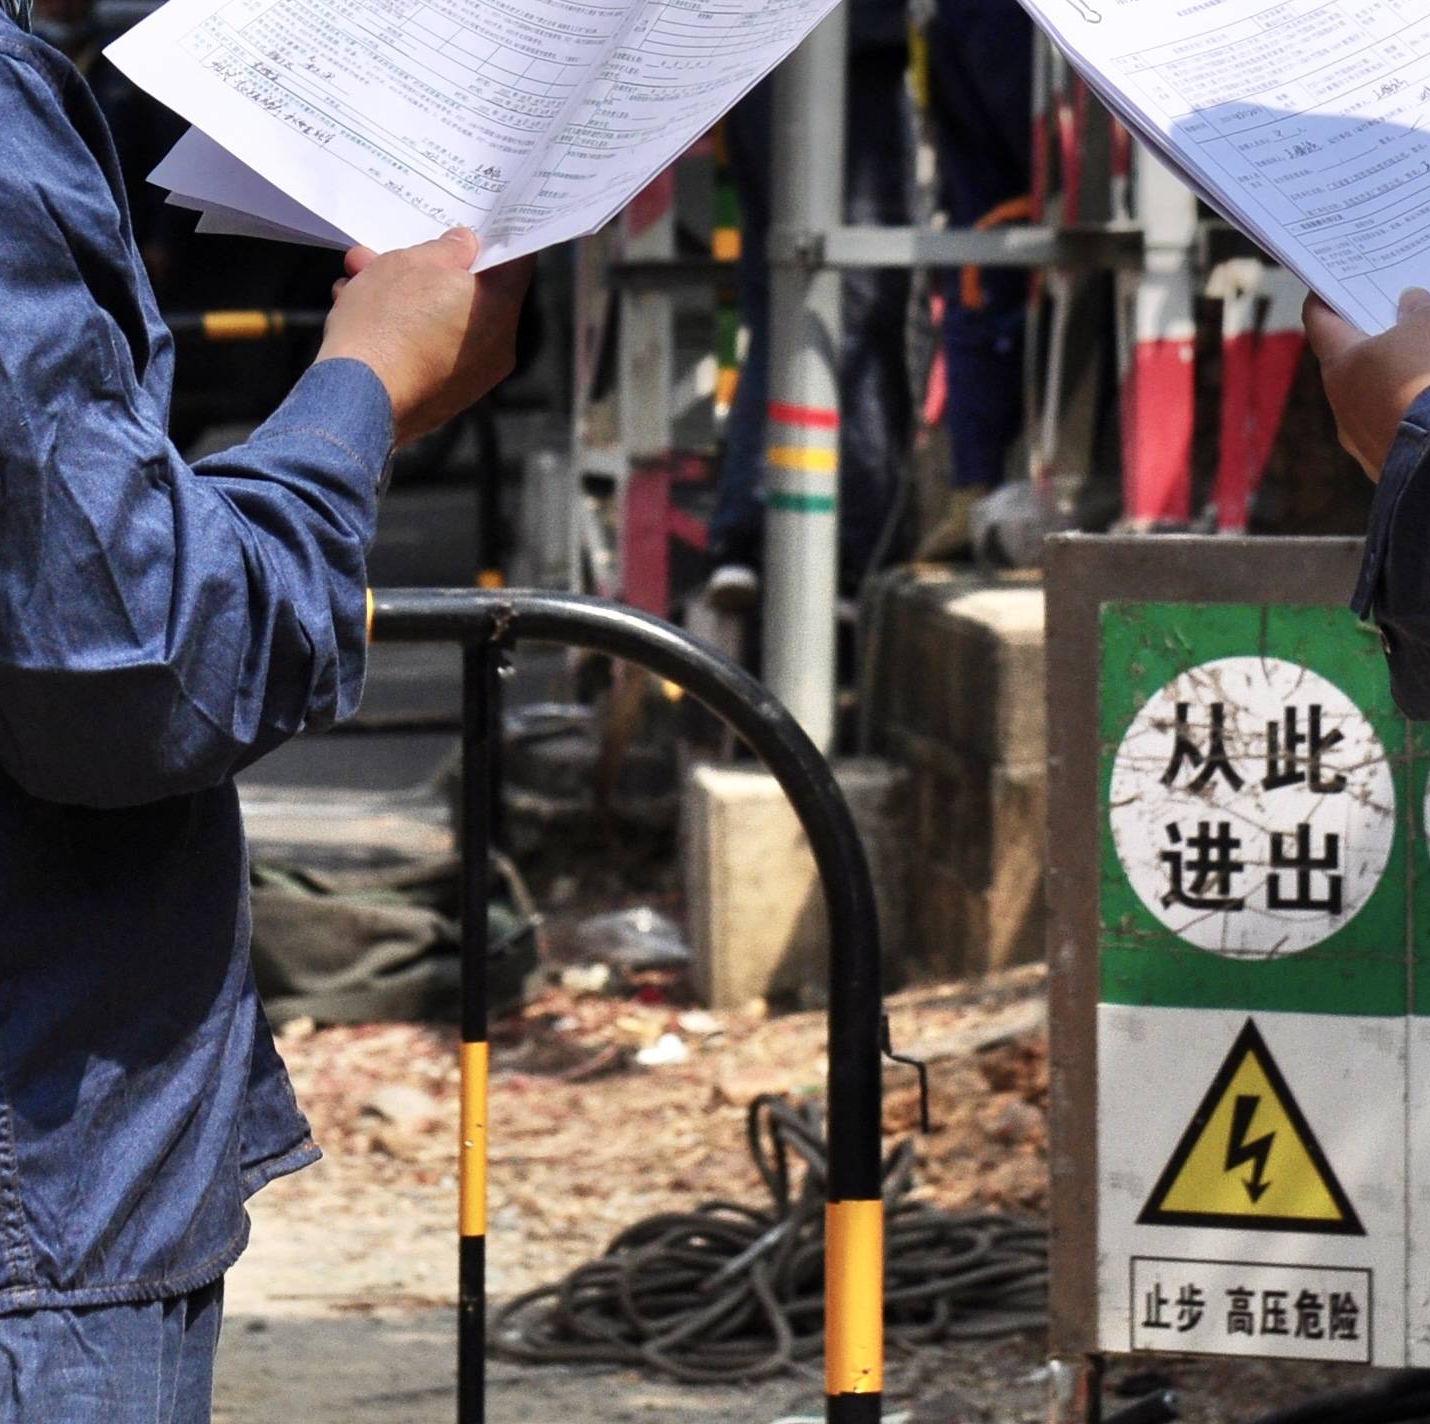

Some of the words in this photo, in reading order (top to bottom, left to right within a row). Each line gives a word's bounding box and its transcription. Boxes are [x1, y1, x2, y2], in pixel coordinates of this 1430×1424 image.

[1159, 700, 1347, 796] 从此
[1161, 821, 1345, 915] 进出
[1142, 1284, 1207, 1333] 止步
[1225, 1287, 1362, 1344] 高压危险
